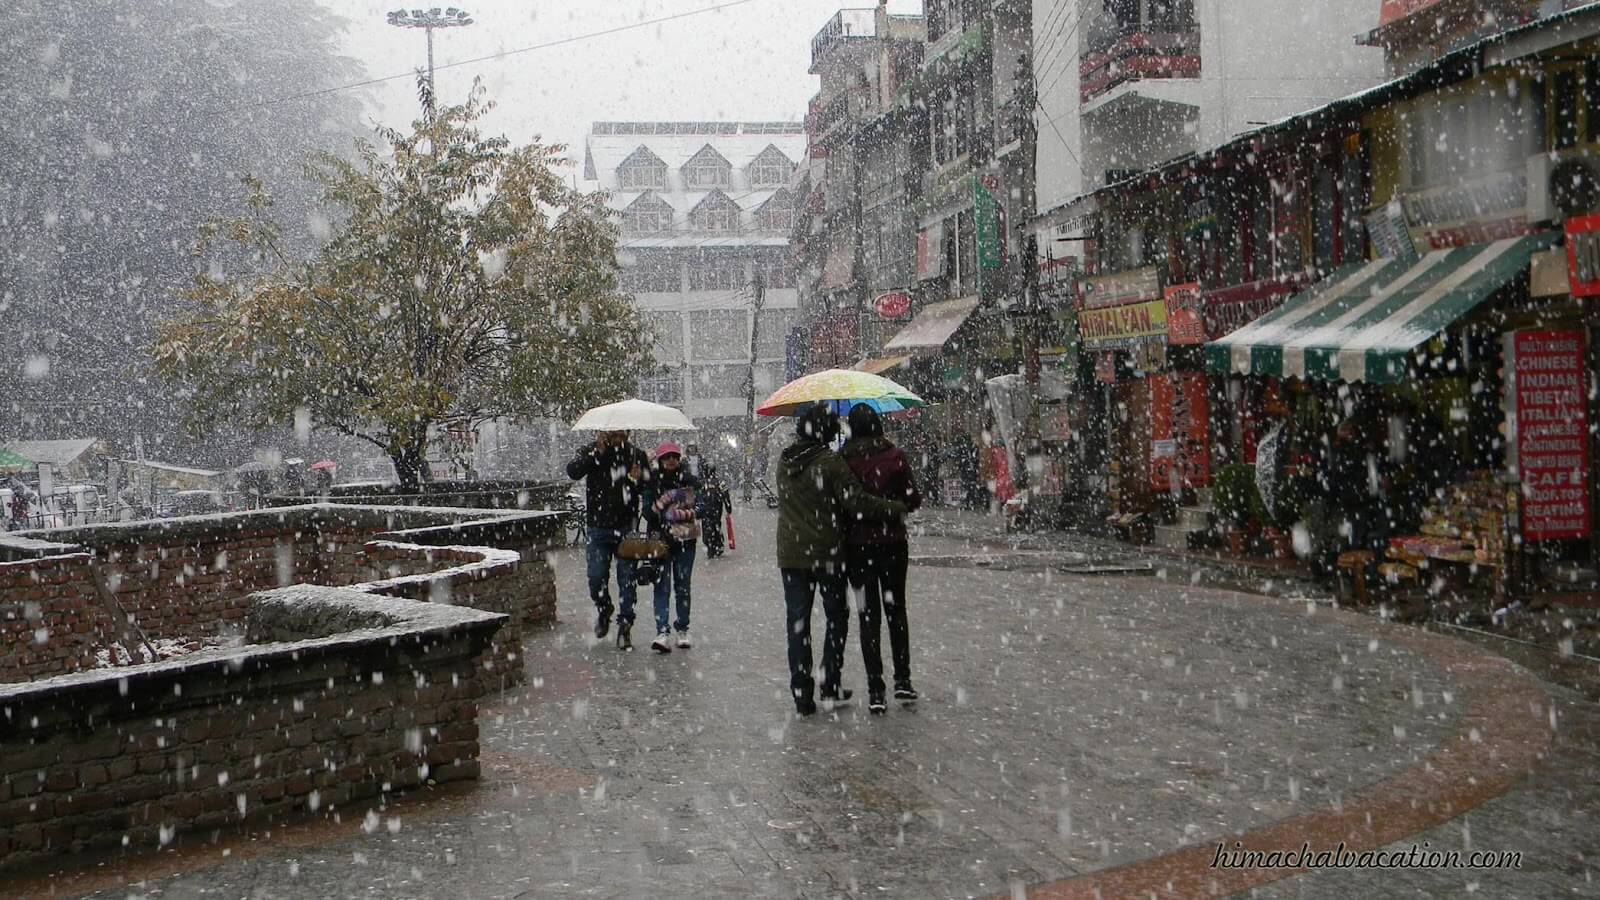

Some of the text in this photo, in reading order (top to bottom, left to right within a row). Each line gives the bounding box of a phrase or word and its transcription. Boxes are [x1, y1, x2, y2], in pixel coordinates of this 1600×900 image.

[1080, 304, 1152, 338] HIMALYAN
[1519, 356, 1577, 369] CHINESE
[1520, 374, 1577, 387] INDIAN
[1521, 391, 1580, 404] TIBETAN
[1521, 409, 1581, 421] ITALIAN
[1522, 439, 1581, 451] CONTINENTAL
[1526, 504, 1584, 517] SEATING
